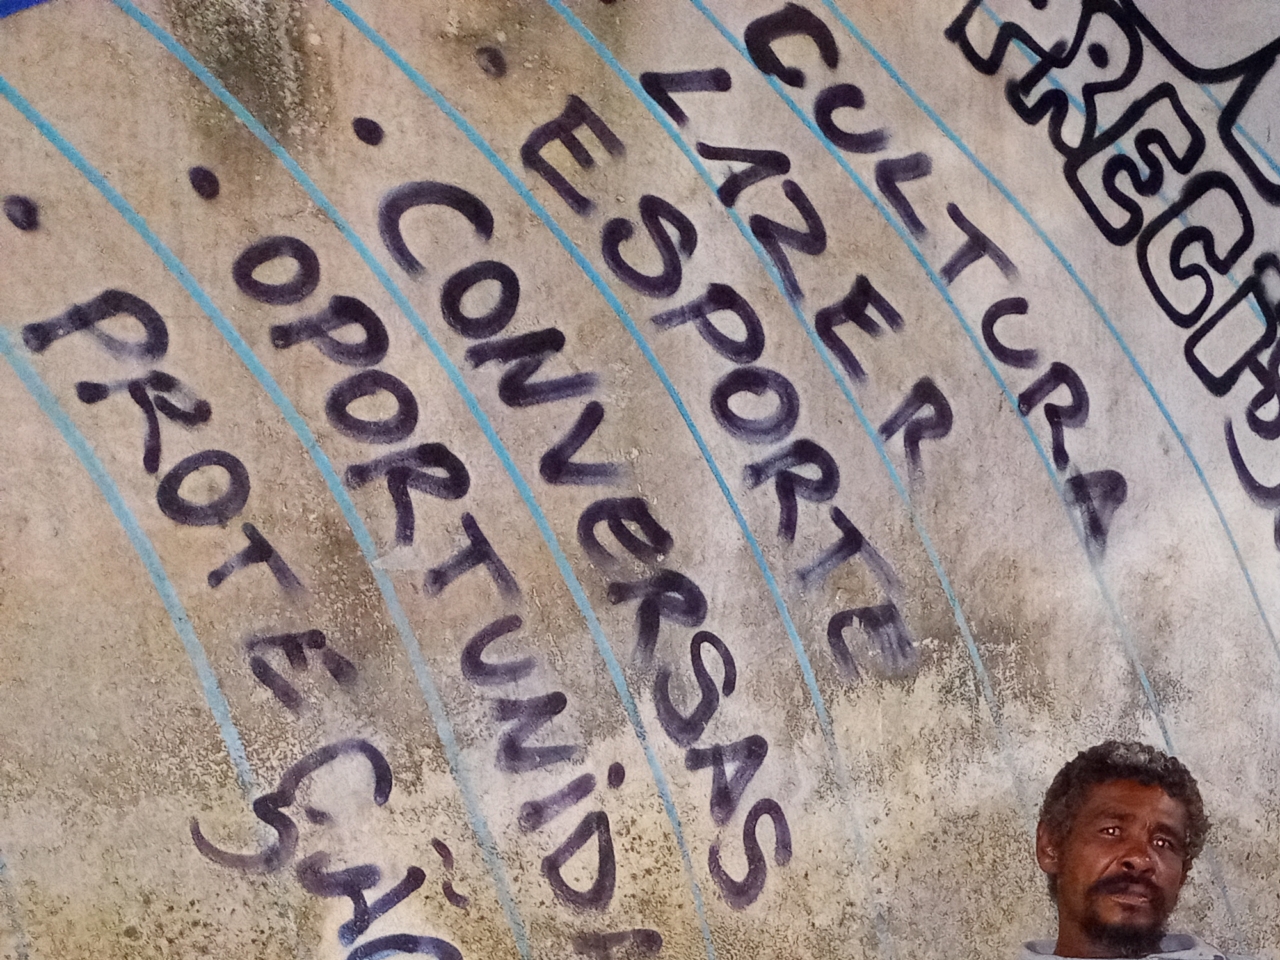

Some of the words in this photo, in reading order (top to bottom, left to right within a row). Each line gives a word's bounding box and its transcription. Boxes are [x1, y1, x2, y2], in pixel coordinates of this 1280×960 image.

[520, 94, 918, 684] ESPORTE
[640, 66, 954, 490] LAZER
[744, 2, 1128, 548] CULTURA
